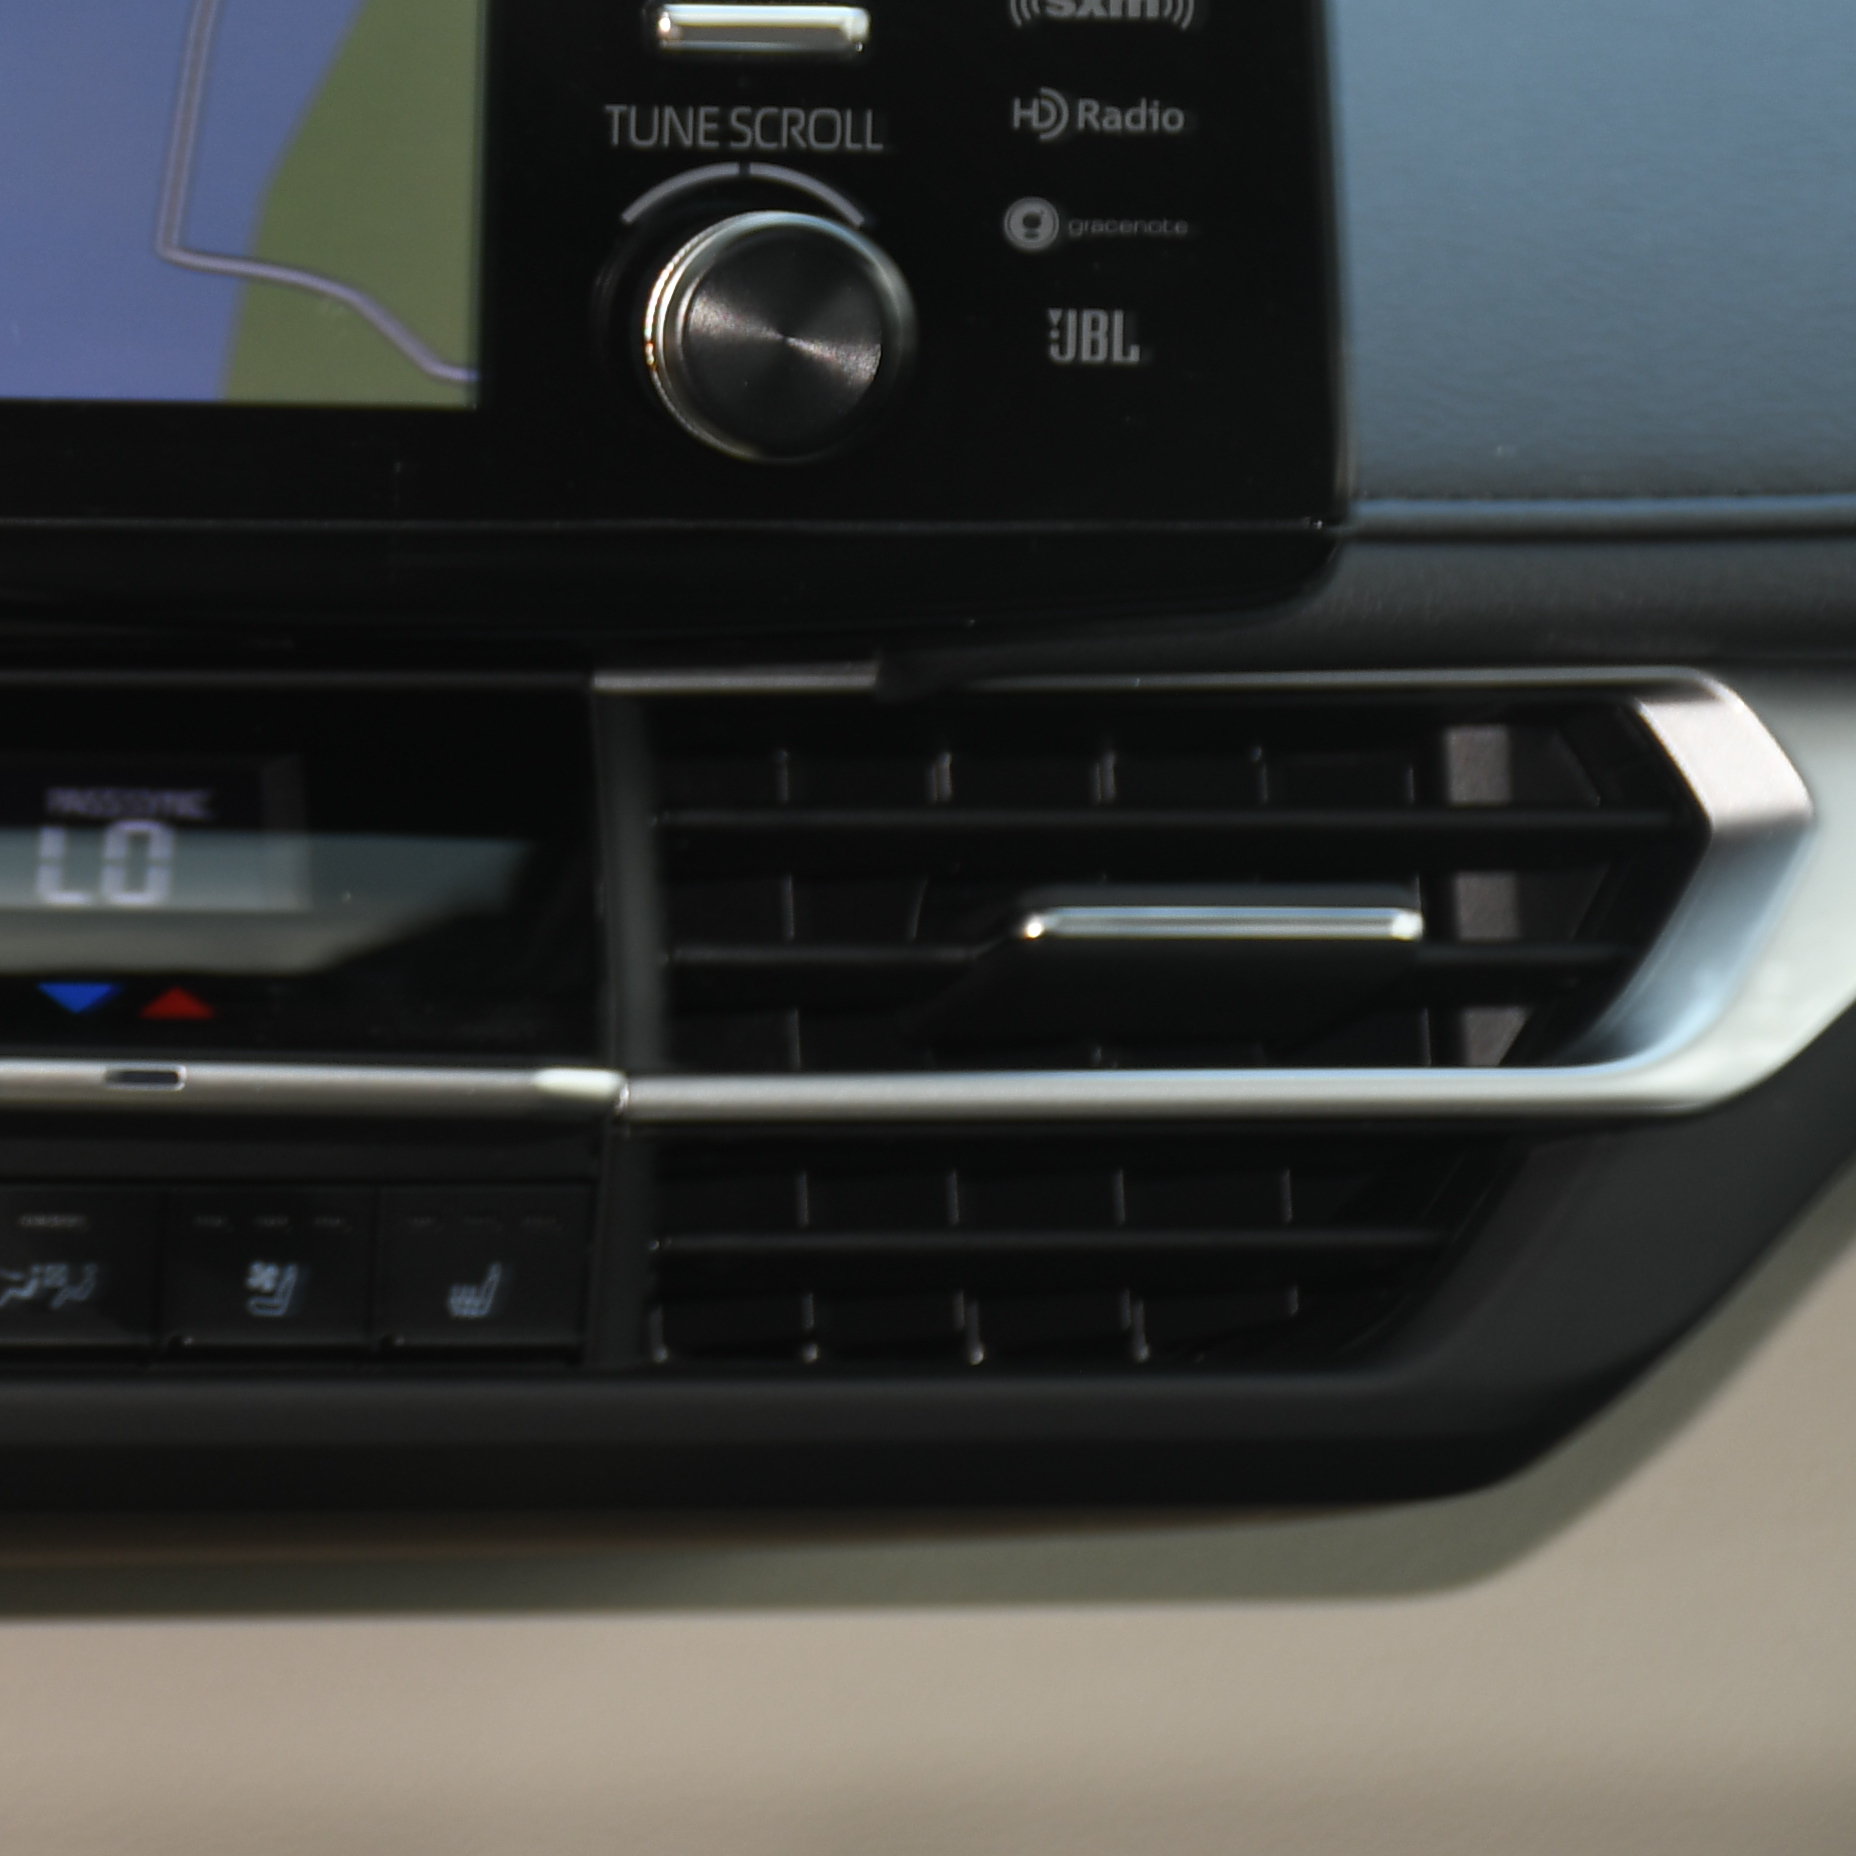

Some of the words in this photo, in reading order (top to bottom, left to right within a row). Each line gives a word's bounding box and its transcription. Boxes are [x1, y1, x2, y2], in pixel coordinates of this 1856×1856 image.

[605, 104, 720, 147] TUNE
[729, 106, 884, 150] SCROLL
[1077, 96, 1186, 133] Radio
[1048, 307, 1142, 363] JBL
